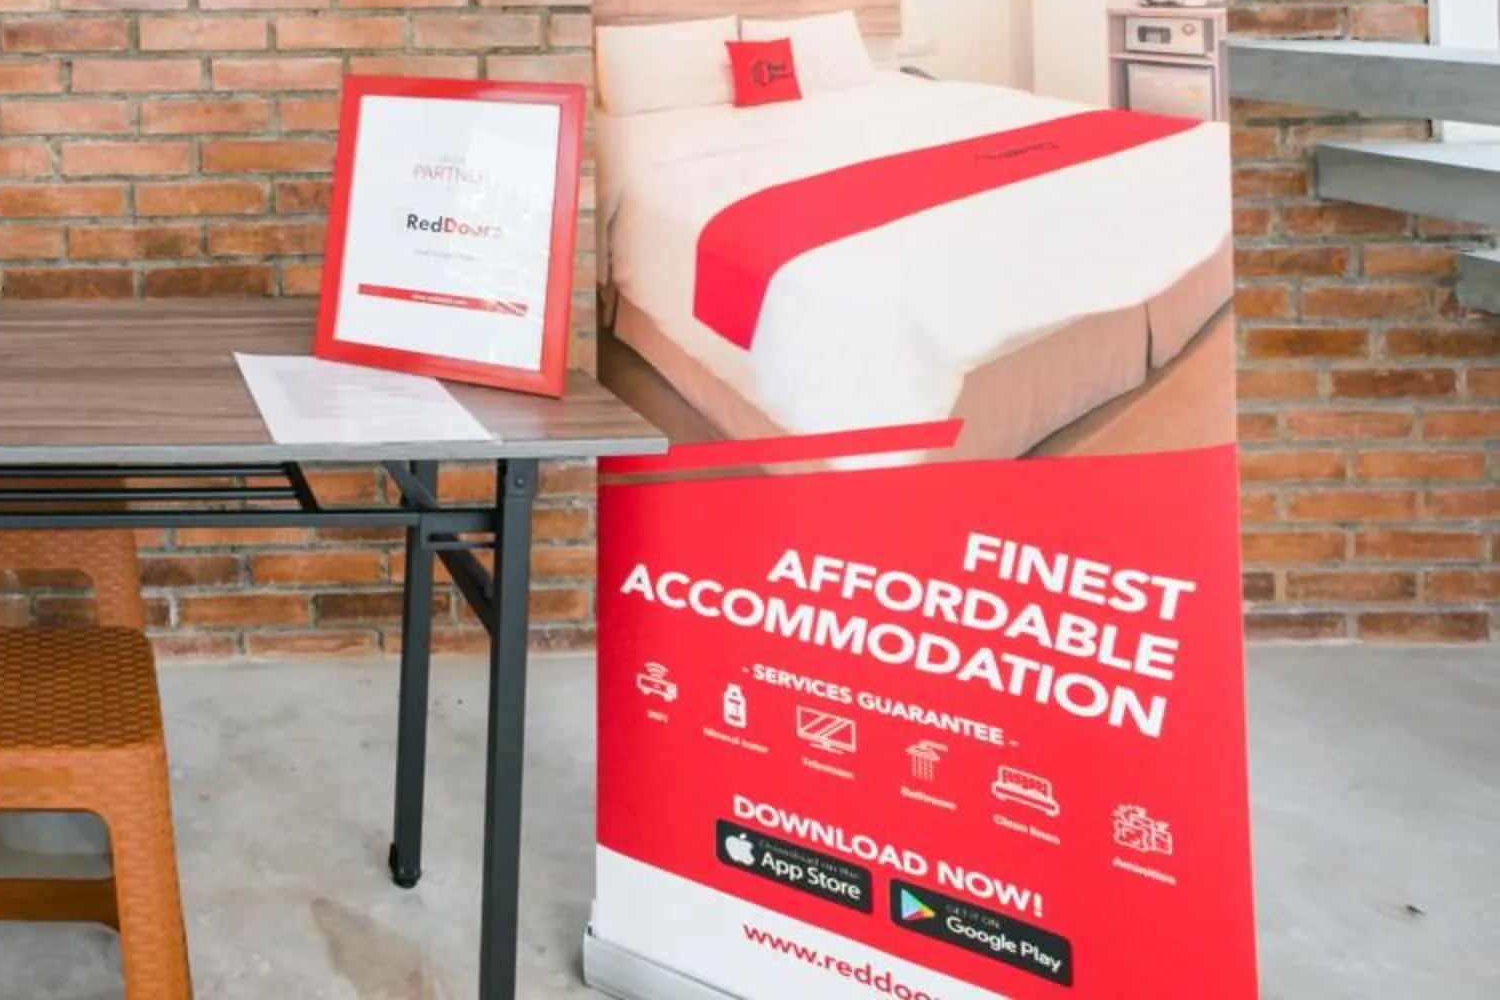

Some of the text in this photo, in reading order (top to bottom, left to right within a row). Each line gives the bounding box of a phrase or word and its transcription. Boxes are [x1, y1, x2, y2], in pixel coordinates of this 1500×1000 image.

[767, 549, 1179, 680] AFFORDABLE
[963, 532, 1196, 622] FINEST
[620, 564, 1167, 738] ACCOMMODATION
[753, 664, 1004, 746] SERVICES GUARANTEE
[733, 794, 1043, 918] DOWNLOAD NOW!
[761, 852, 861, 900] App Store
[743, 923, 939, 1000] www.reddoo
[946, 915, 1062, 974] Google Play
